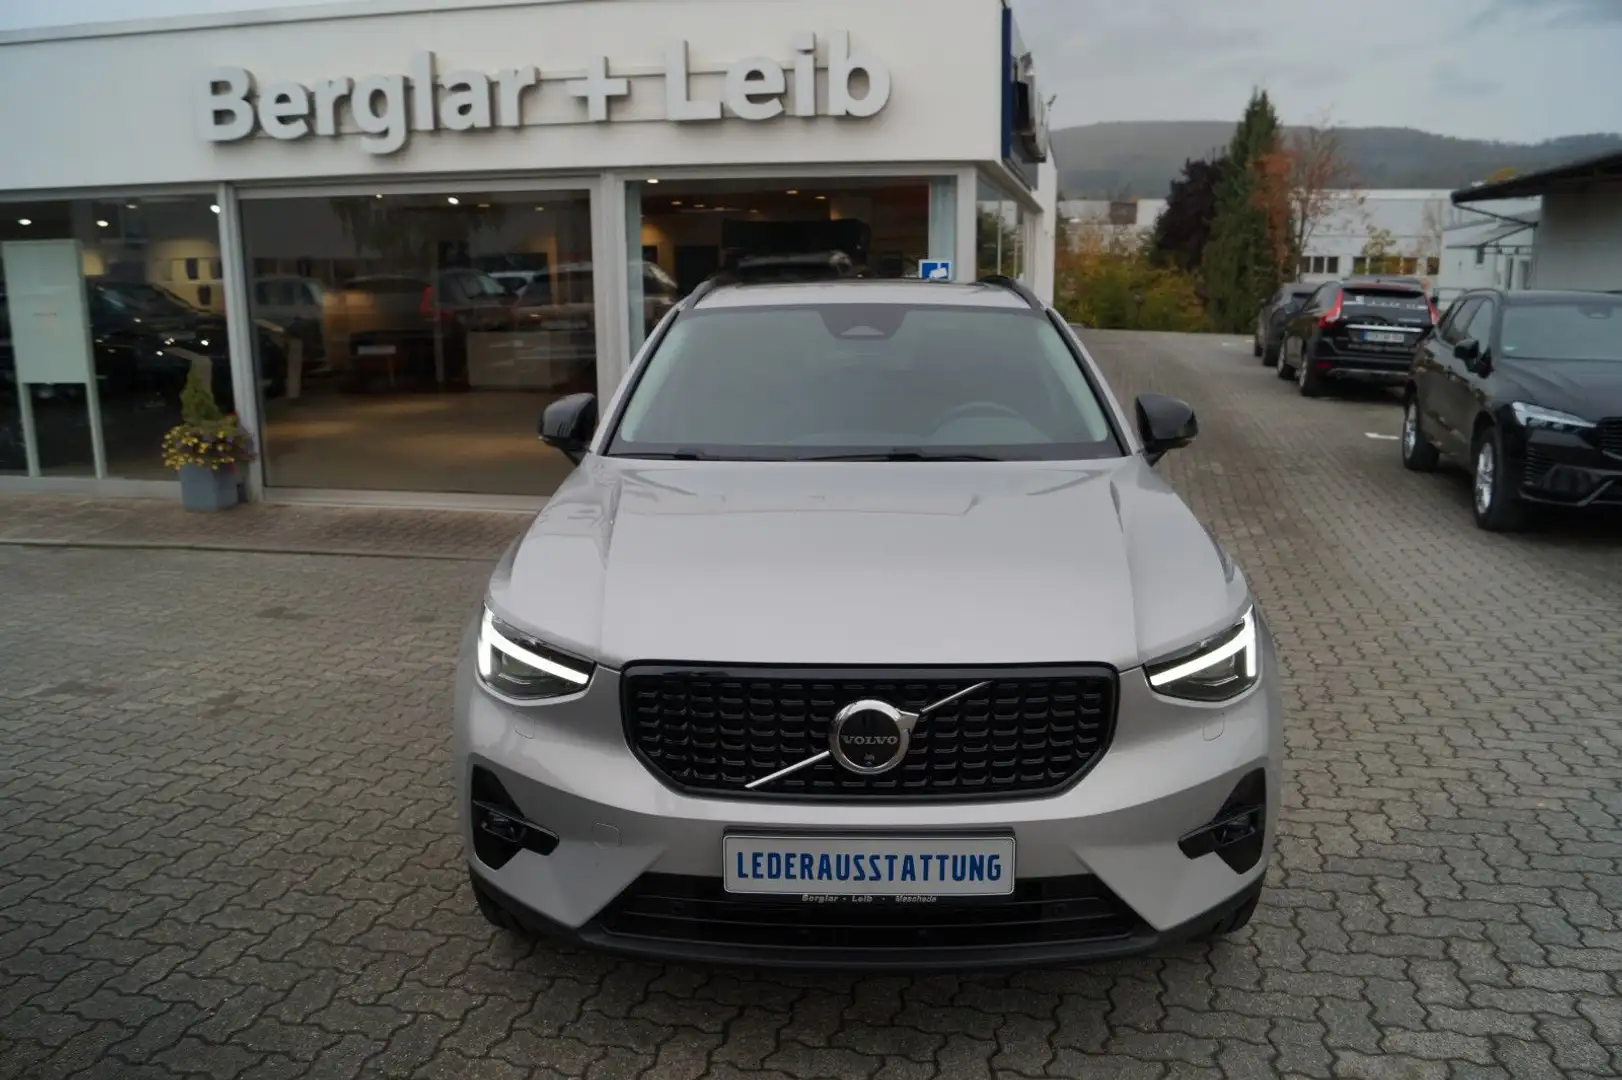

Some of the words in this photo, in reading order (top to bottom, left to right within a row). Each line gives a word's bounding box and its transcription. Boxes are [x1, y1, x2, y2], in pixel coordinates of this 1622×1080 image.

[200, 51, 540, 154] Berglar
[664, 31, 892, 121] Leib
[840, 735, 898, 745] VOLVO
[736, 851, 1001, 882] LEDERAUSSTATTUNG
